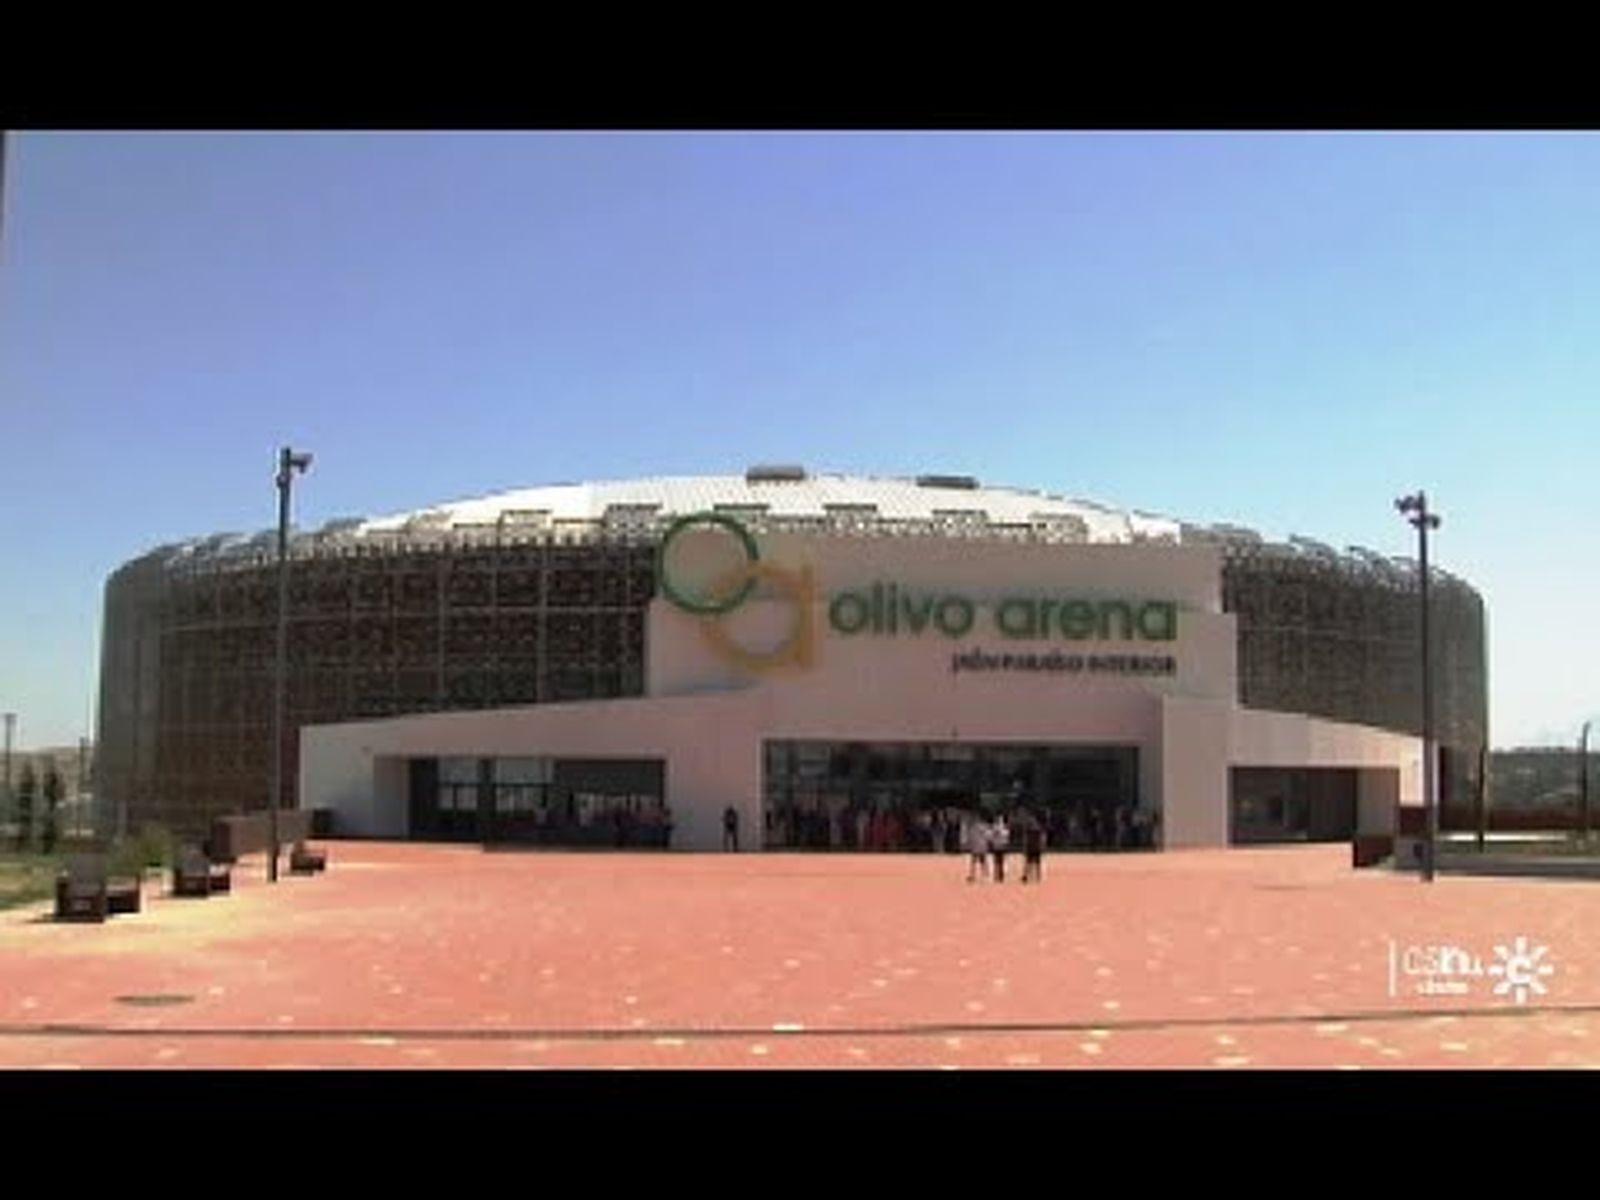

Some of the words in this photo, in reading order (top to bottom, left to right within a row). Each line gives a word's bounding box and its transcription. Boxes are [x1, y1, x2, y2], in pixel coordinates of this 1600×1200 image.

[829, 581, 974, 641] olivo
[993, 597, 1178, 642] arena
[1087, 653, 1178, 677] INTERIOR
